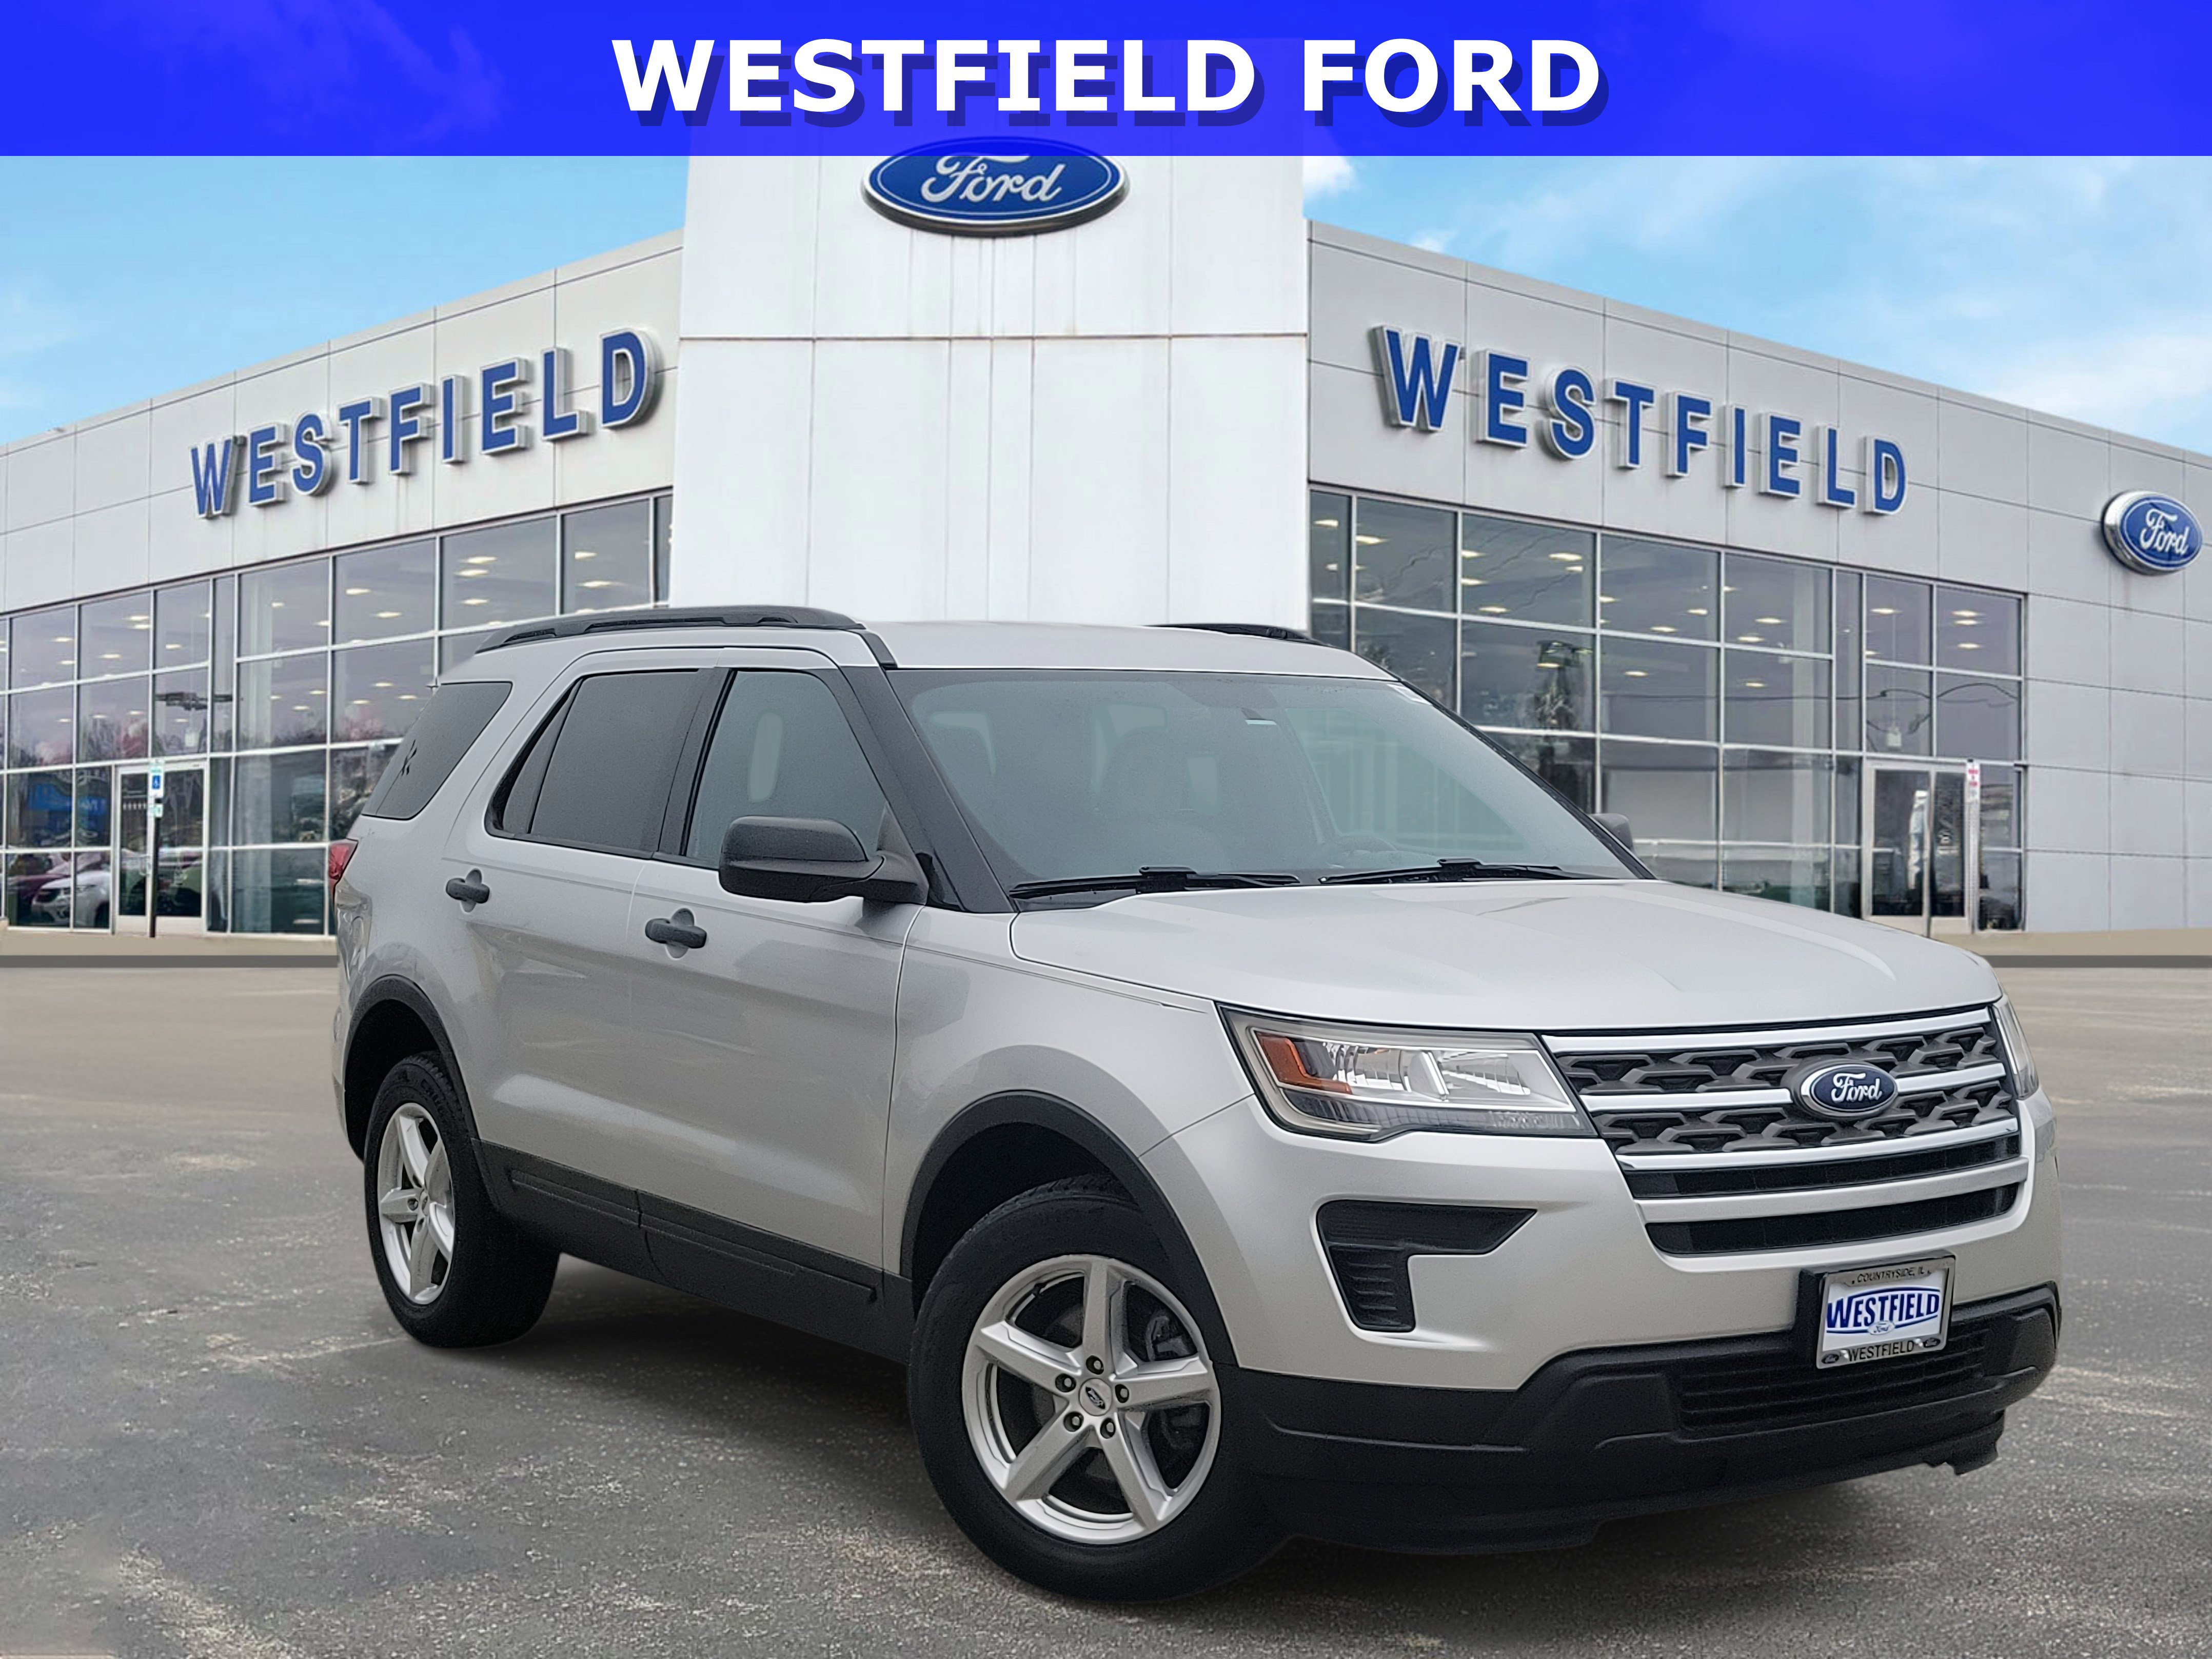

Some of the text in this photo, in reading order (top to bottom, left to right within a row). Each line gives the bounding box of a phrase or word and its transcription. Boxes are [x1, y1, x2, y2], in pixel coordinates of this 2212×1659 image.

[921, 152, 1066, 203] Ford
[190, 329, 659, 519] WESTFIELD
[1377, 325, 1907, 515] WESTFIELD
[2140, 508, 2189, 555] Ford
[1831, 1073, 1883, 1103] Ford
[1826, 1293, 1940, 1329] WESTFIELD
[1848, 1340, 1914, 1362] WESTFIELD
